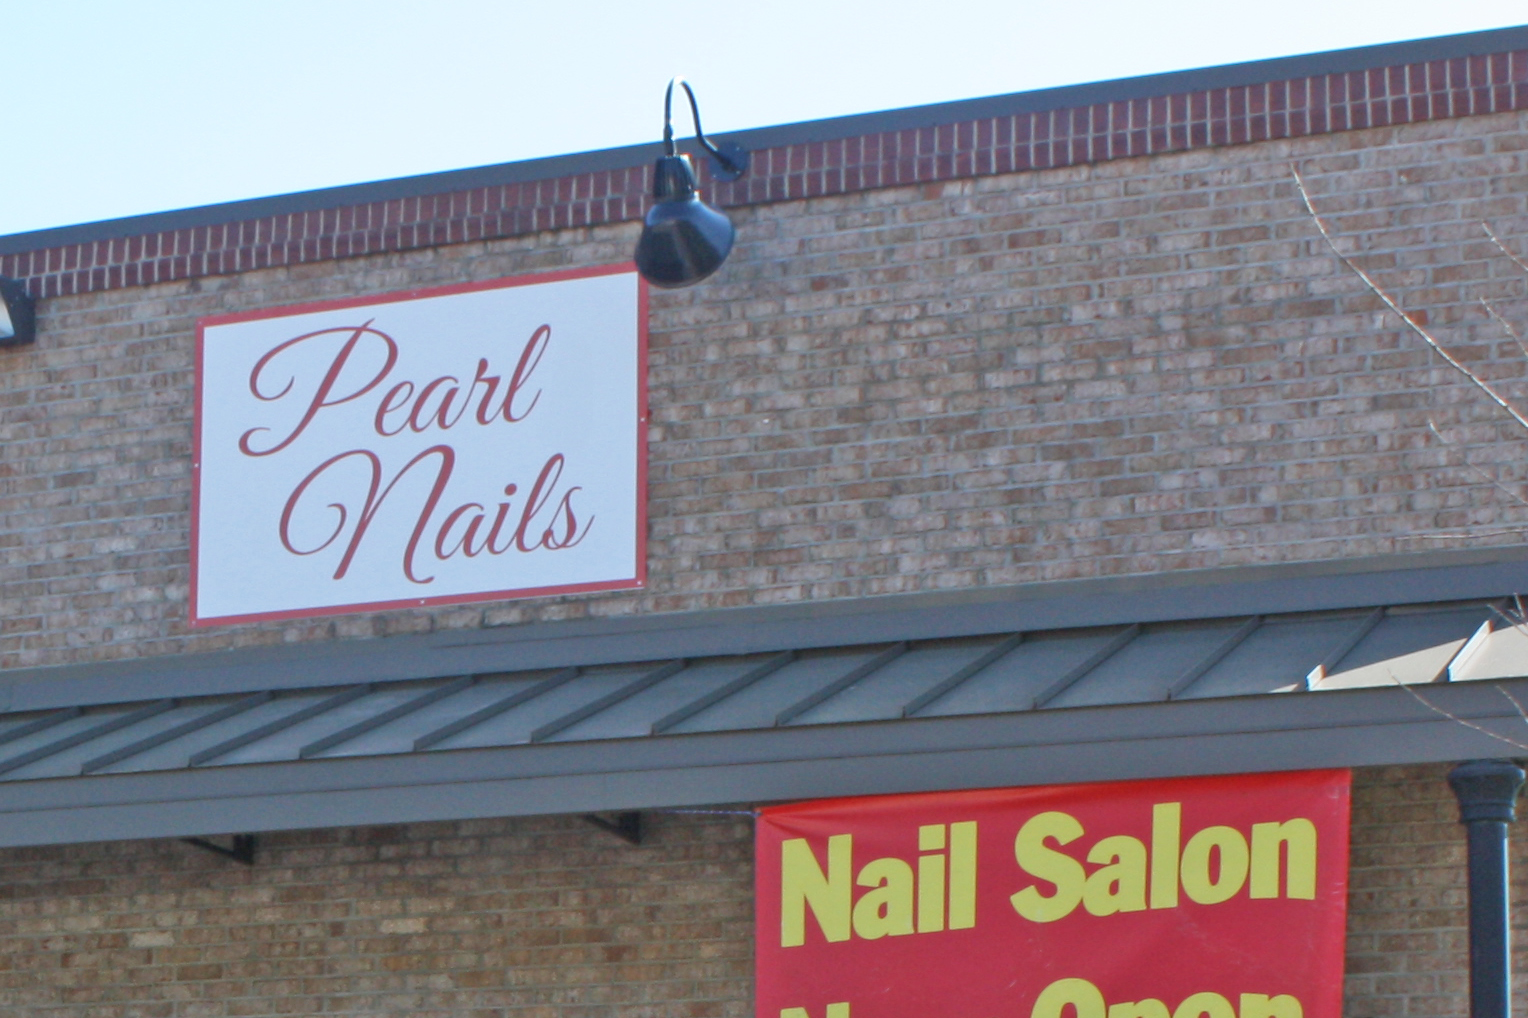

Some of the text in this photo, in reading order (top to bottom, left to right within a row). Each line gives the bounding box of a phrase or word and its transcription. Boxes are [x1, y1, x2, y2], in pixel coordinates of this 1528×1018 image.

[238, 318, 551, 457] Pearl
[279, 444, 595, 584] Nails
[781, 801, 1317, 948] Nail Salon
